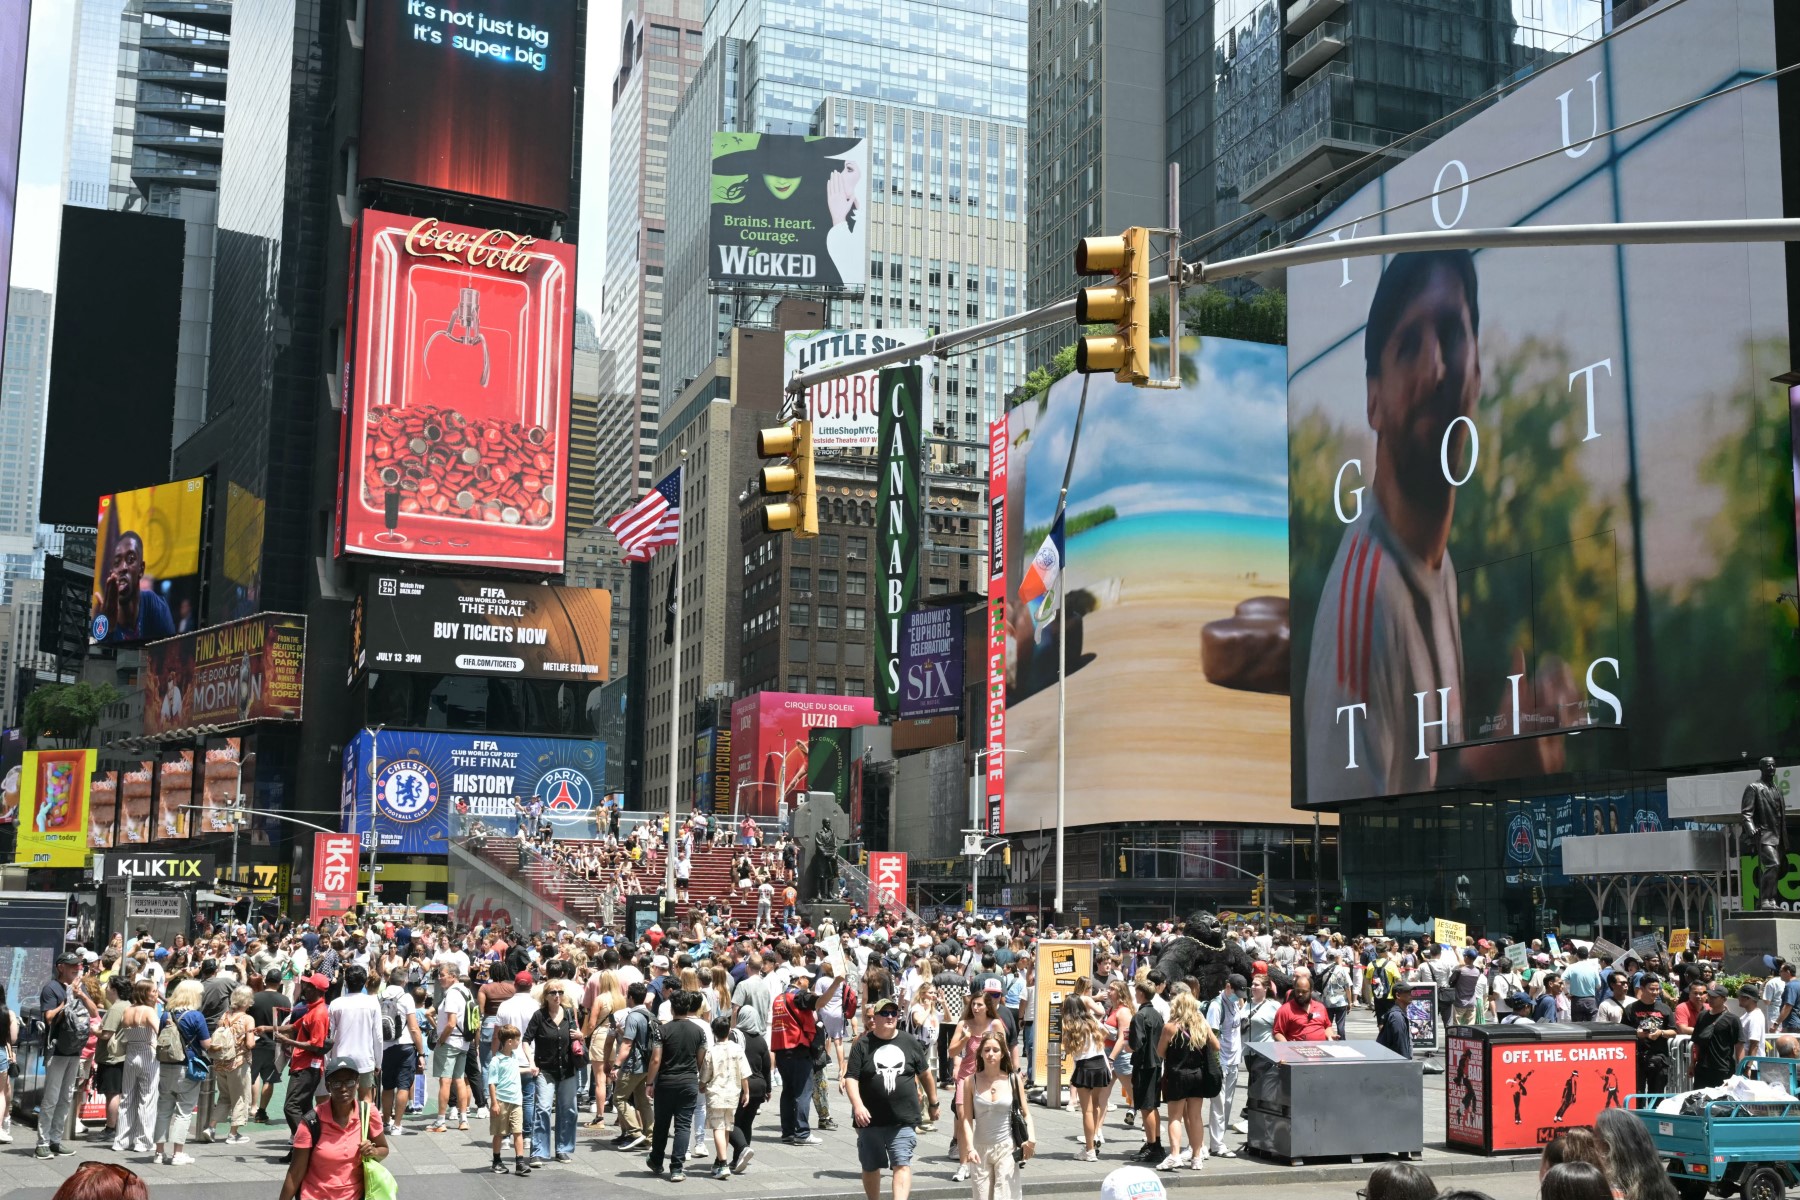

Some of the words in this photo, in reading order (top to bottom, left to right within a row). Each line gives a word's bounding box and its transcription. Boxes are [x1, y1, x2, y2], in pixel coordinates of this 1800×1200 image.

[407, 0, 436, 19] It's
[440, 9, 474, 28] not
[476, 13, 513, 35] just
[518, 23, 549, 48] big
[413, 24, 442, 44] It's
[452, 35, 511, 58] super
[515, 46, 546, 71] big
[1329, 72, 1602, 288] YOU
[723, 215, 771, 228] Brains.
[774, 217, 816, 230] Heart.
[740, 229, 799, 245] Courage.
[799, 334, 867, 371] LITTLE
[819, 427, 879, 436] LittleShopNYC.
[993, 413, 1006, 480] STORE
[1333, 358, 1612, 523] GOT
[888, 382, 905, 695] CANNABIS
[994, 506, 1004, 572] HERSHEY'S
[480, 587, 506, 599] FIFA
[460, 603, 485, 614] THE
[488, 604, 524, 617] FINAL
[911, 608, 951, 627] BROADWAY'S
[991, 596, 1005, 649] FREE
[195, 631, 215, 662] FIND
[217, 620, 265, 660] SALVATION
[433, 621, 460, 640] BUY
[463, 623, 514, 643] TICKETS
[517, 627, 547, 645] NOW
[271, 650, 303, 659] SOUTH
[275, 658, 299, 667] PARK
[376, 652, 393, 662] JULY
[394, 652, 402, 662] 13
[405, 653, 422, 664] 3PM
[463, 657, 517, 669] FIFA.COM/TICKETS
[543, 662, 569, 673] METLIFE
[570, 664, 599, 674] STADIUM
[194, 672, 207, 684] THE
[208, 666, 228, 683] BOOK
[229, 663, 240, 678] OF
[269, 682, 302, 690] ROBERT
[271, 690, 299, 699] LOPEZ
[785, 701, 814, 712] CIRQUE
[816, 702, 827, 710] DU
[1336, 657, 1622, 770] THIS
[801, 713, 838, 728] LUZIA
[989, 653, 1003, 781] CHOCOLATE
[473, 740, 498, 751] FIFA
[716, 730, 731, 773] PATRICIA
[387, 761, 429, 778] CHELSEA
[452, 756, 478, 767] THE
[481, 757, 517, 769] FINAL
[453, 774, 515, 795] HISTORY
[545, 771, 584, 786] PARIS
[384, 806, 413, 820] FOOTBALL
[413, 807, 428, 819] CLUB
[470, 796, 516, 816] YOURS
[58, 834, 77, 842] today
[117, 859, 202, 877] KLIKTIX
[324, 837, 353, 891] tkts
[877, 855, 902, 905] tkts
[164, 908, 179, 916] MOVING
[1437, 921, 1459, 931] JESUS
[1445, 934, 1463, 942] TRUTH
[1052, 950, 1073, 958] EXPLORE
[1449, 1038, 1463, 1050] BEAT
[1465, 1041, 1482, 1049] THRILLER
[1449, 1050, 1463, 1066] IT
[1502, 1050, 1532, 1064] OFF.
[1534, 1049, 1567, 1063] THE.
[1568, 1047, 1628, 1062] CHARTS.
[1468, 1065, 1482, 1082] BAD
[1449, 1083, 1466, 1092] BILLIE
[1538, 1127, 1555, 1143] MJ
[1128, 1181, 1161, 1195] NASA
